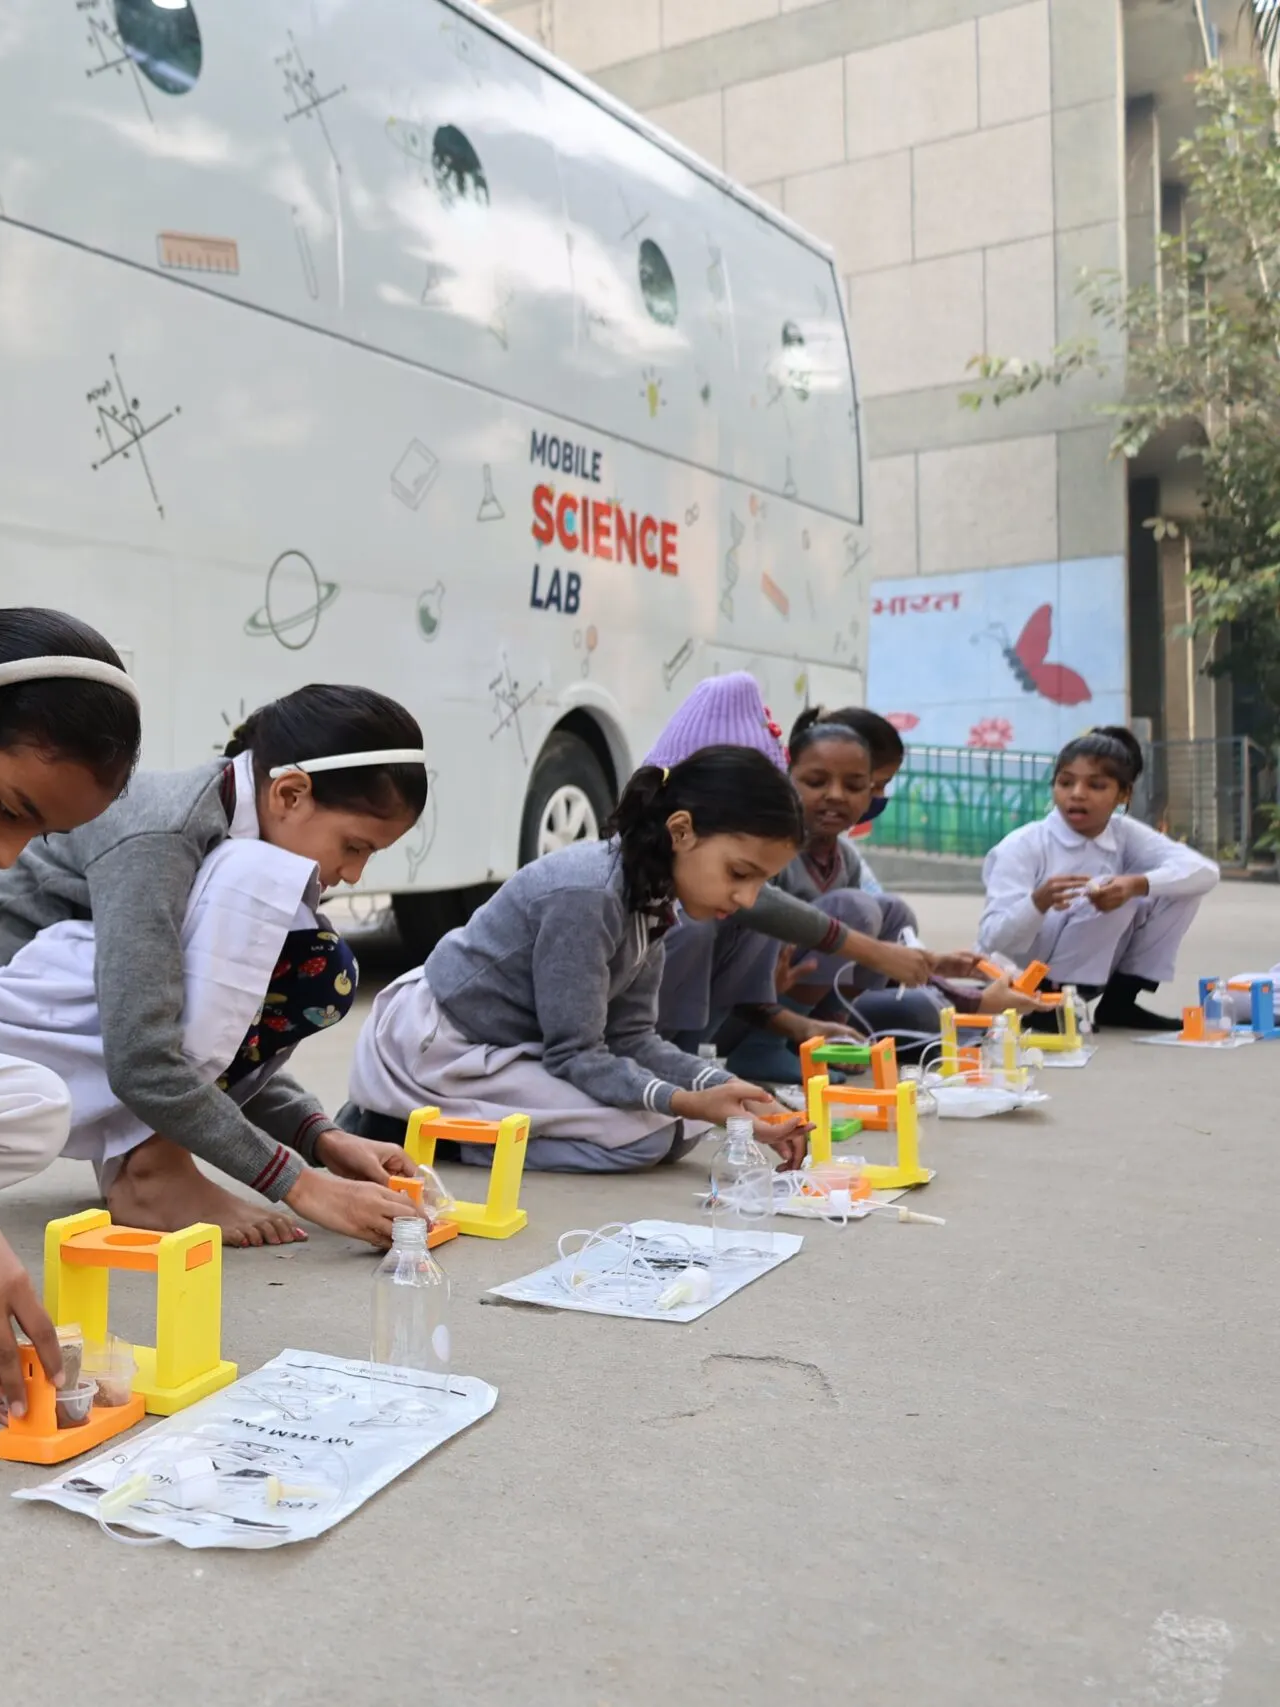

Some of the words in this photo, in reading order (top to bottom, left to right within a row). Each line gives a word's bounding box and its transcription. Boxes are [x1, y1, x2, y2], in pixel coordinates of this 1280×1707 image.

[530, 429, 602, 483] MOBILE
[531, 482, 679, 577] SCIENCE
[529, 563, 582, 614] LAB
[871, 590, 963, 617] भारत
[231, 1417, 267, 1432] LAB
[268, 1427, 321, 1442] STEM
[321, 1434, 355, 1449] MY
